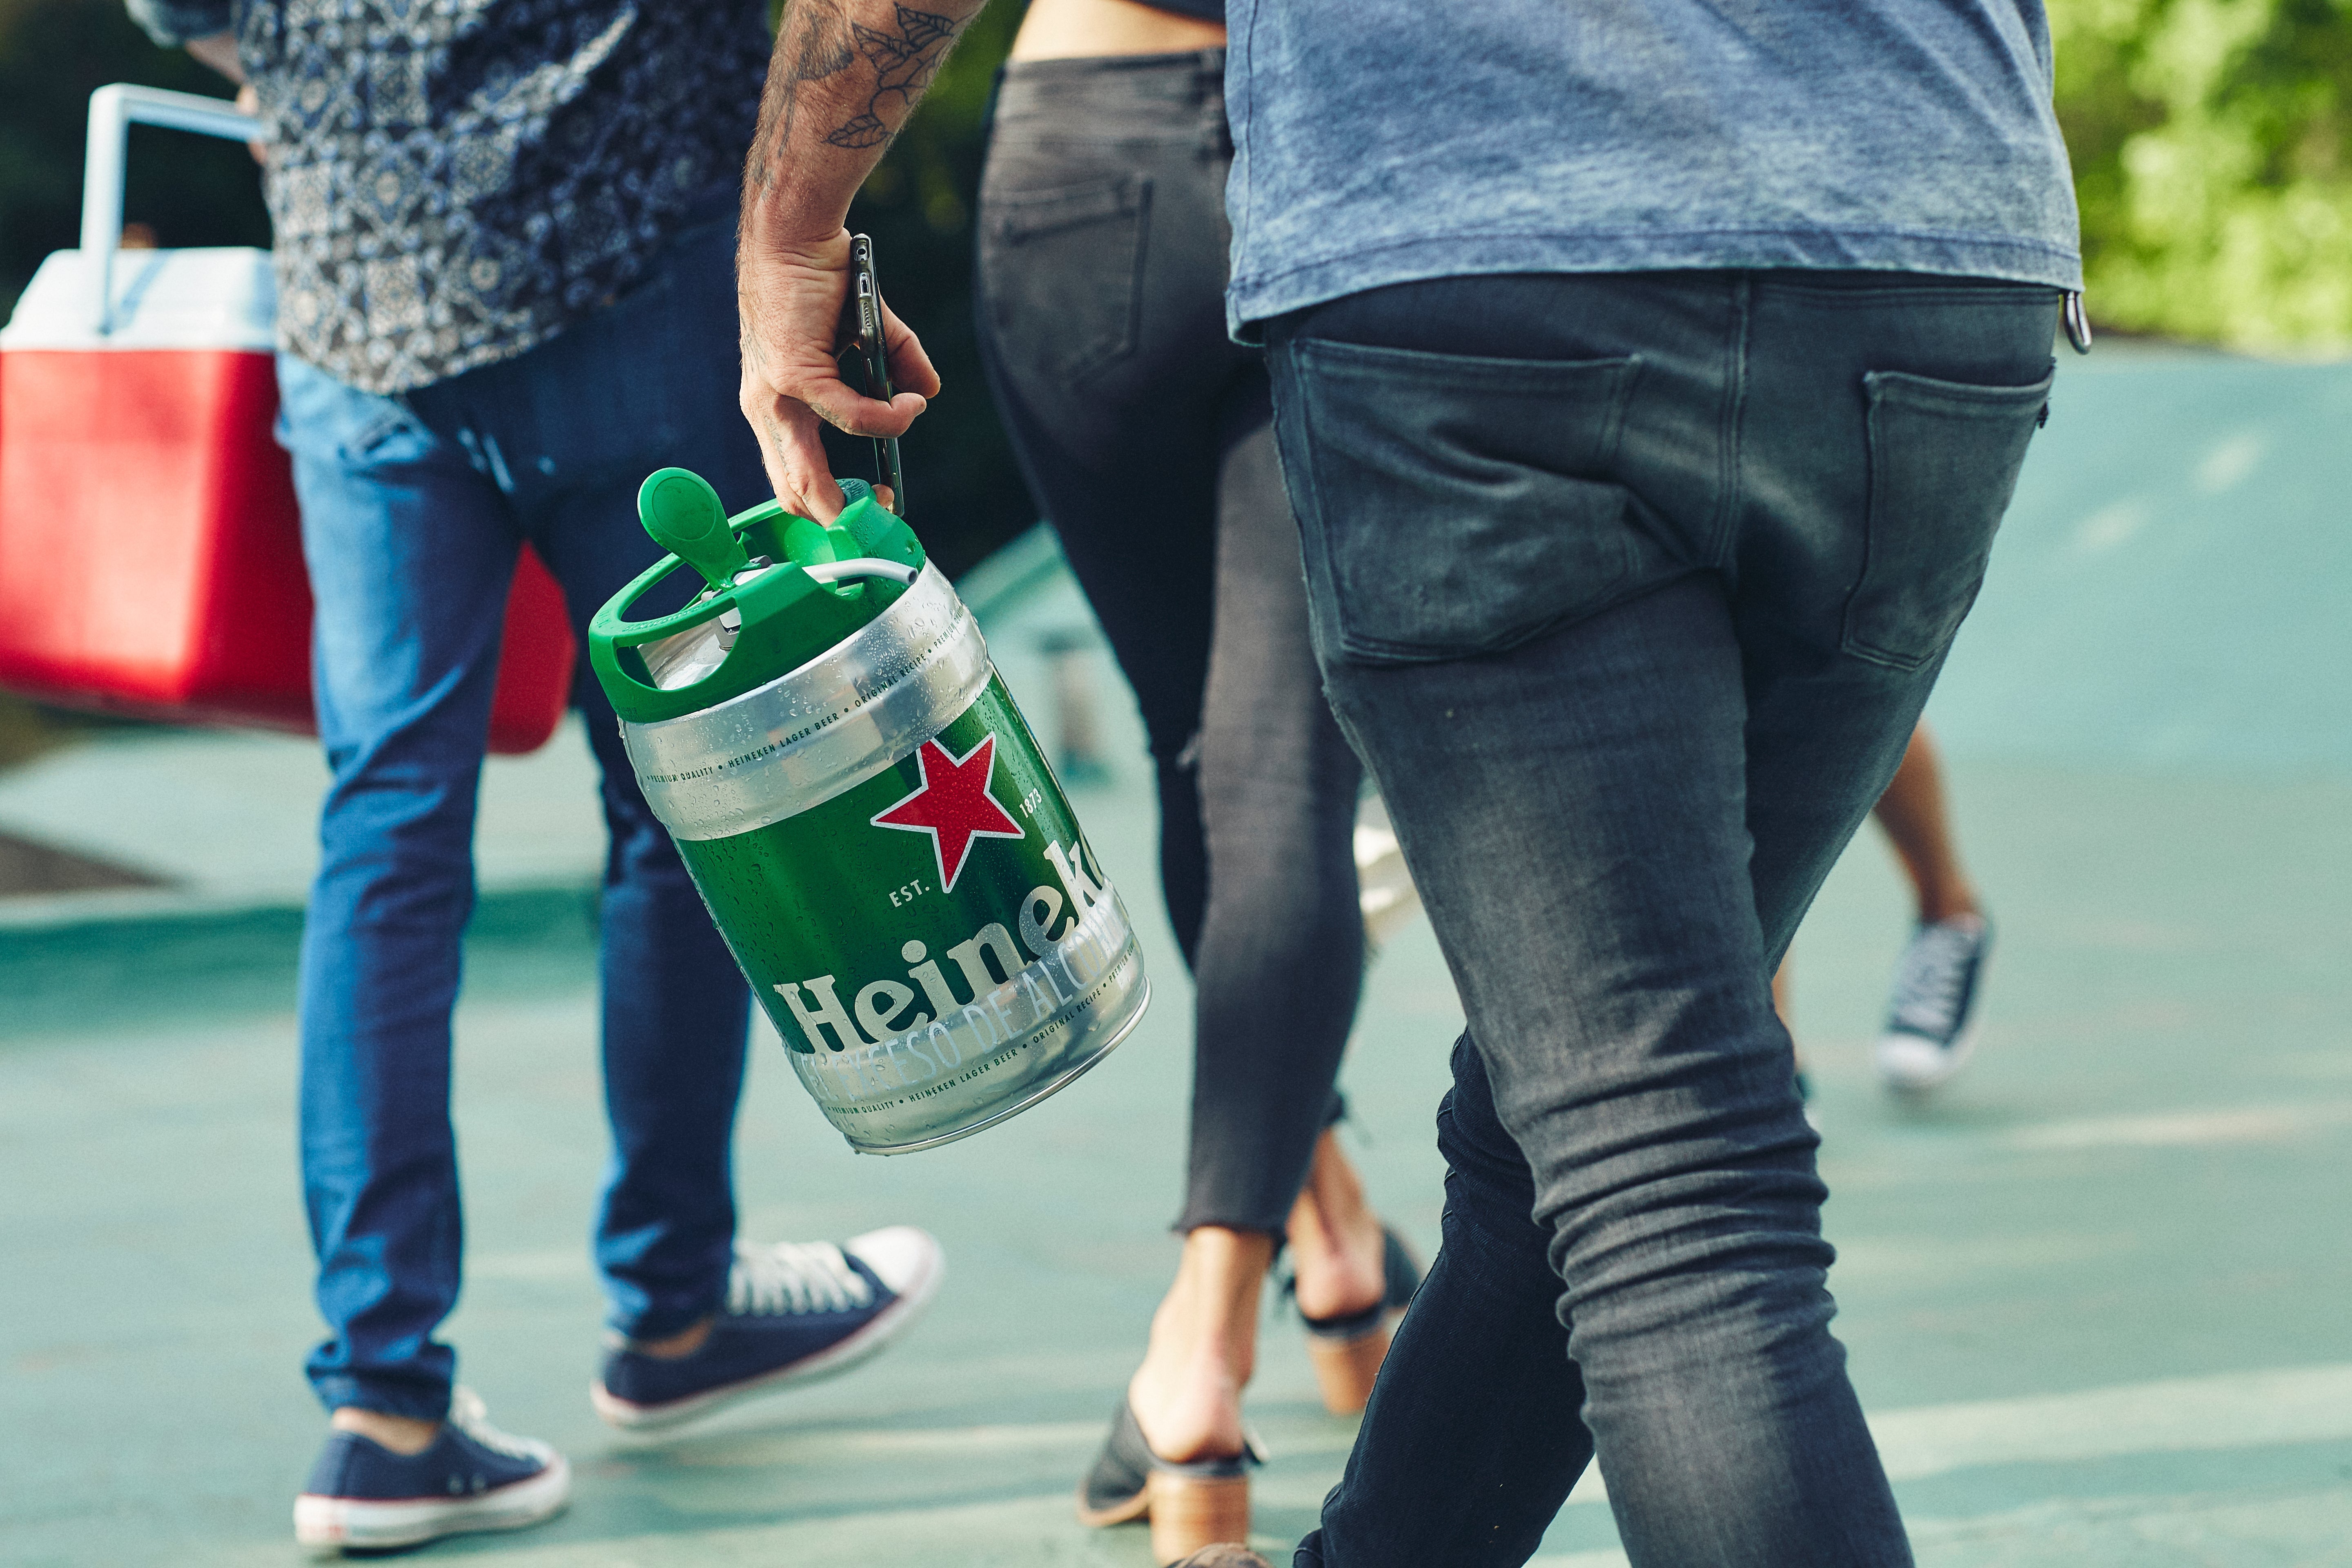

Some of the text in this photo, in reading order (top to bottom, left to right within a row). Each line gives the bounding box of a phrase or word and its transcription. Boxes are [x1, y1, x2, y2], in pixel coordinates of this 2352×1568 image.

[650, 774, 678, 783] PREMIUM
[680, 766, 713, 780] QUALITY
[728, 744, 775, 768] HEINEKEN
[780, 728, 811, 747] LAGER
[815, 713, 839, 731] BEER
[855, 676, 898, 707] ORIGINAL
[900, 653, 926, 677] RECIPE
[934, 622, 956, 648] PREMIUM
[1019, 788, 1042, 818] 1873
[773, 840, 1105, 1054] Heinek
[889, 879, 930, 908] EST.
[831, 1022, 961, 1102] EXCESO
[962, 989, 1024, 1054] DE
[862, 1101, 894, 1113] QUALITY
[909, 1079, 956, 1102] HEINEKEN
[960, 1064, 990, 1082] LAGER
[994, 1049, 1018, 1066] BEER
[1033, 1011, 1074, 1043] ORIGINAL
[1076, 988, 1101, 1013] RECIPE
[1109, 955, 1128, 982] PREMIUM
